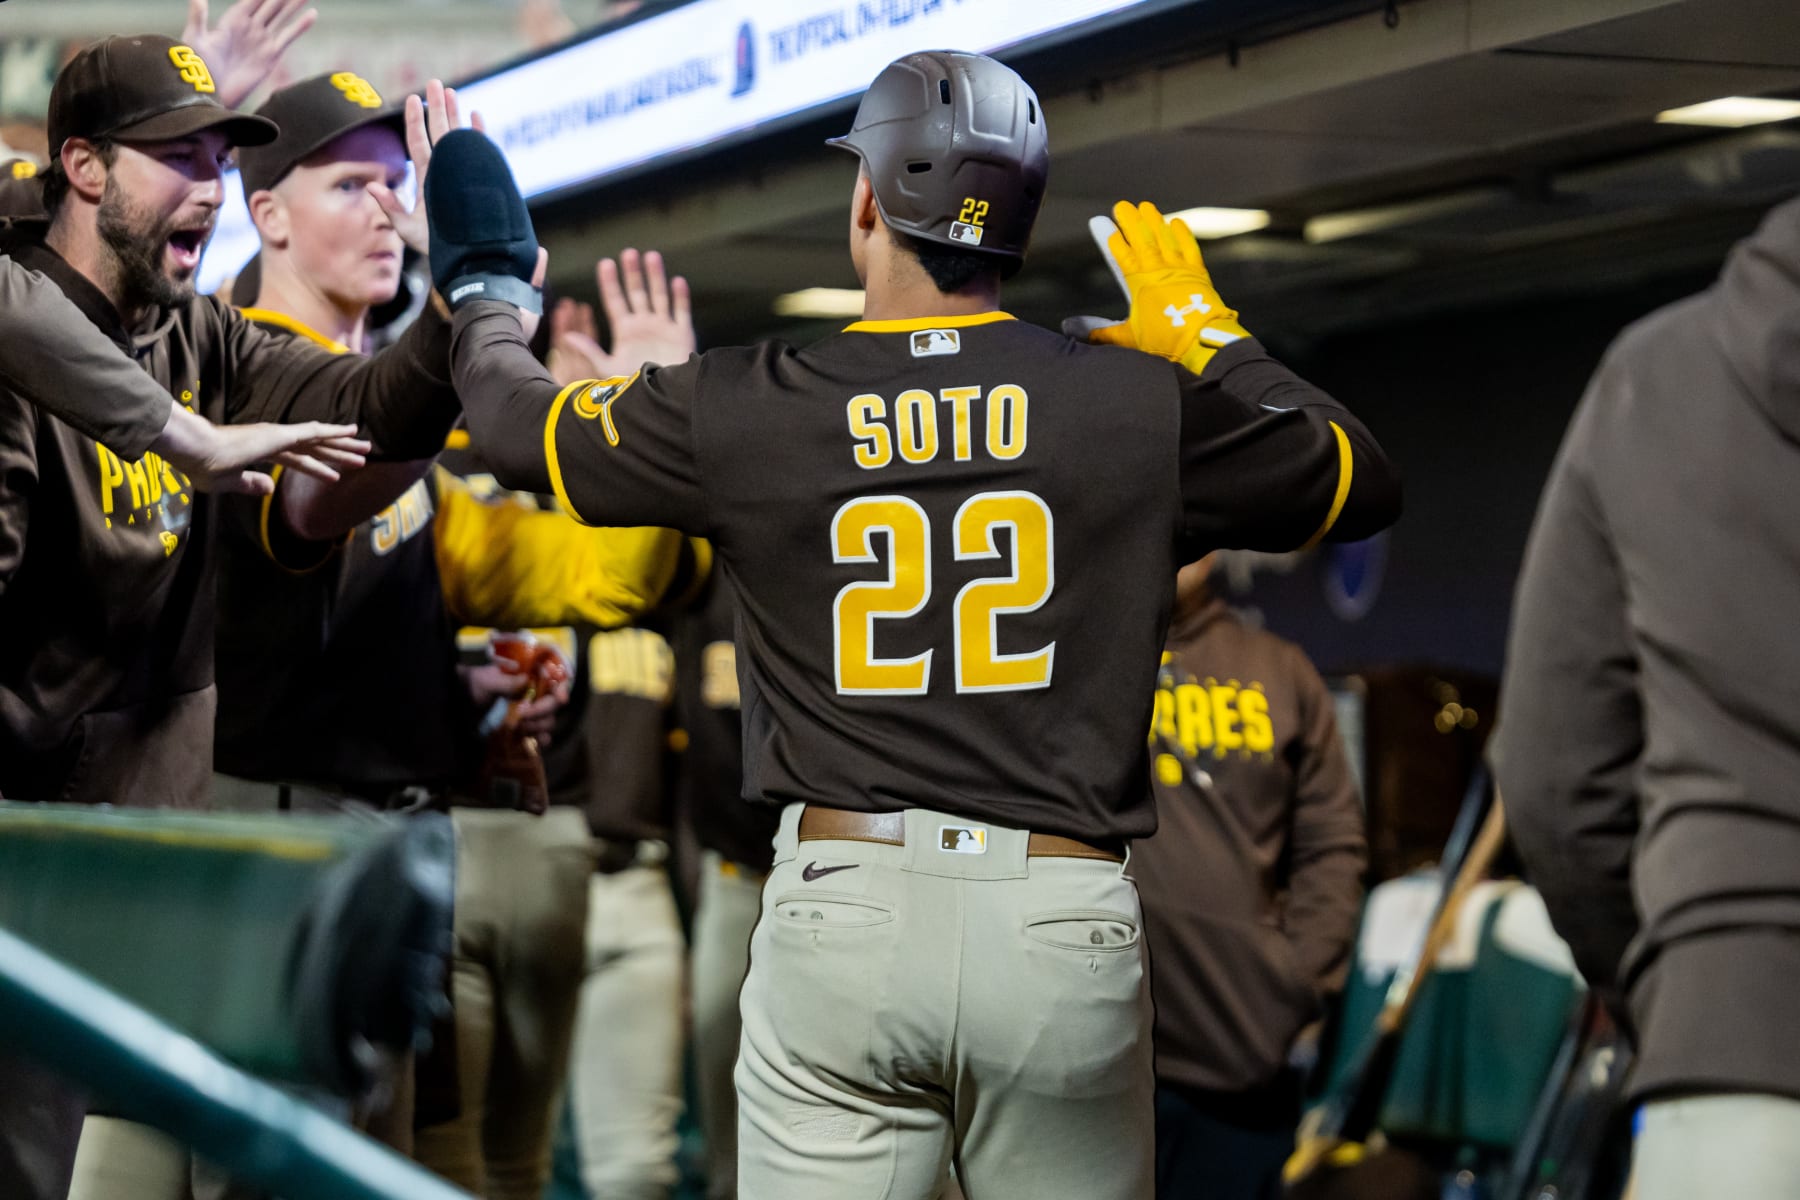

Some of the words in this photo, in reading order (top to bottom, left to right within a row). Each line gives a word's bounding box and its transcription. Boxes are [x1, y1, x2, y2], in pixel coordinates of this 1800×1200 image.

[959, 197, 989, 226] 22
[847, 384, 1028, 469] SOTO
[830, 490, 1056, 695] 22
